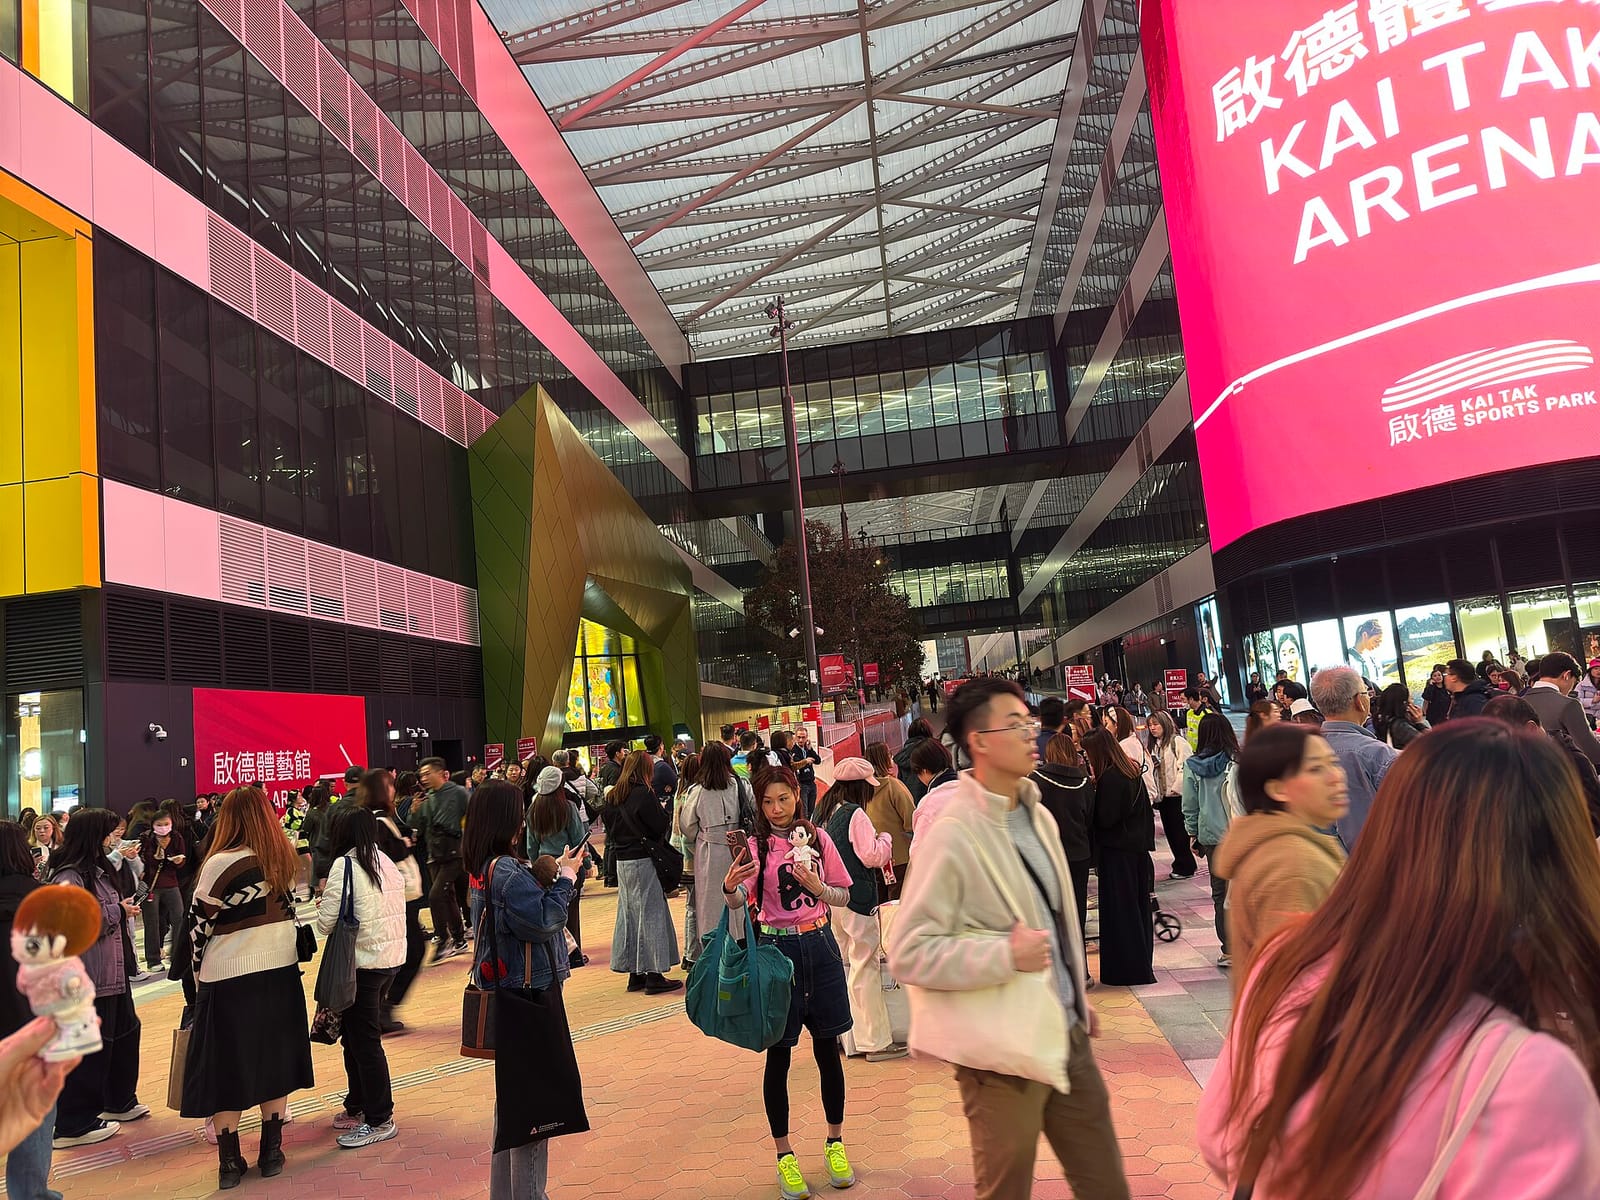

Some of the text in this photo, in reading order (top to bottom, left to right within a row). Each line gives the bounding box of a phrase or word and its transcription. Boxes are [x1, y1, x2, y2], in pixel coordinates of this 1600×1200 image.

[1260, 26, 1600, 195] KAI TAK
[1461, 384, 1538, 412] KAI TAK
[1463, 391, 1598, 427] SPORTS PARK
[1388, 403, 1458, 446] 啟德
[213, 750, 311, 785] 啟德體藝館
